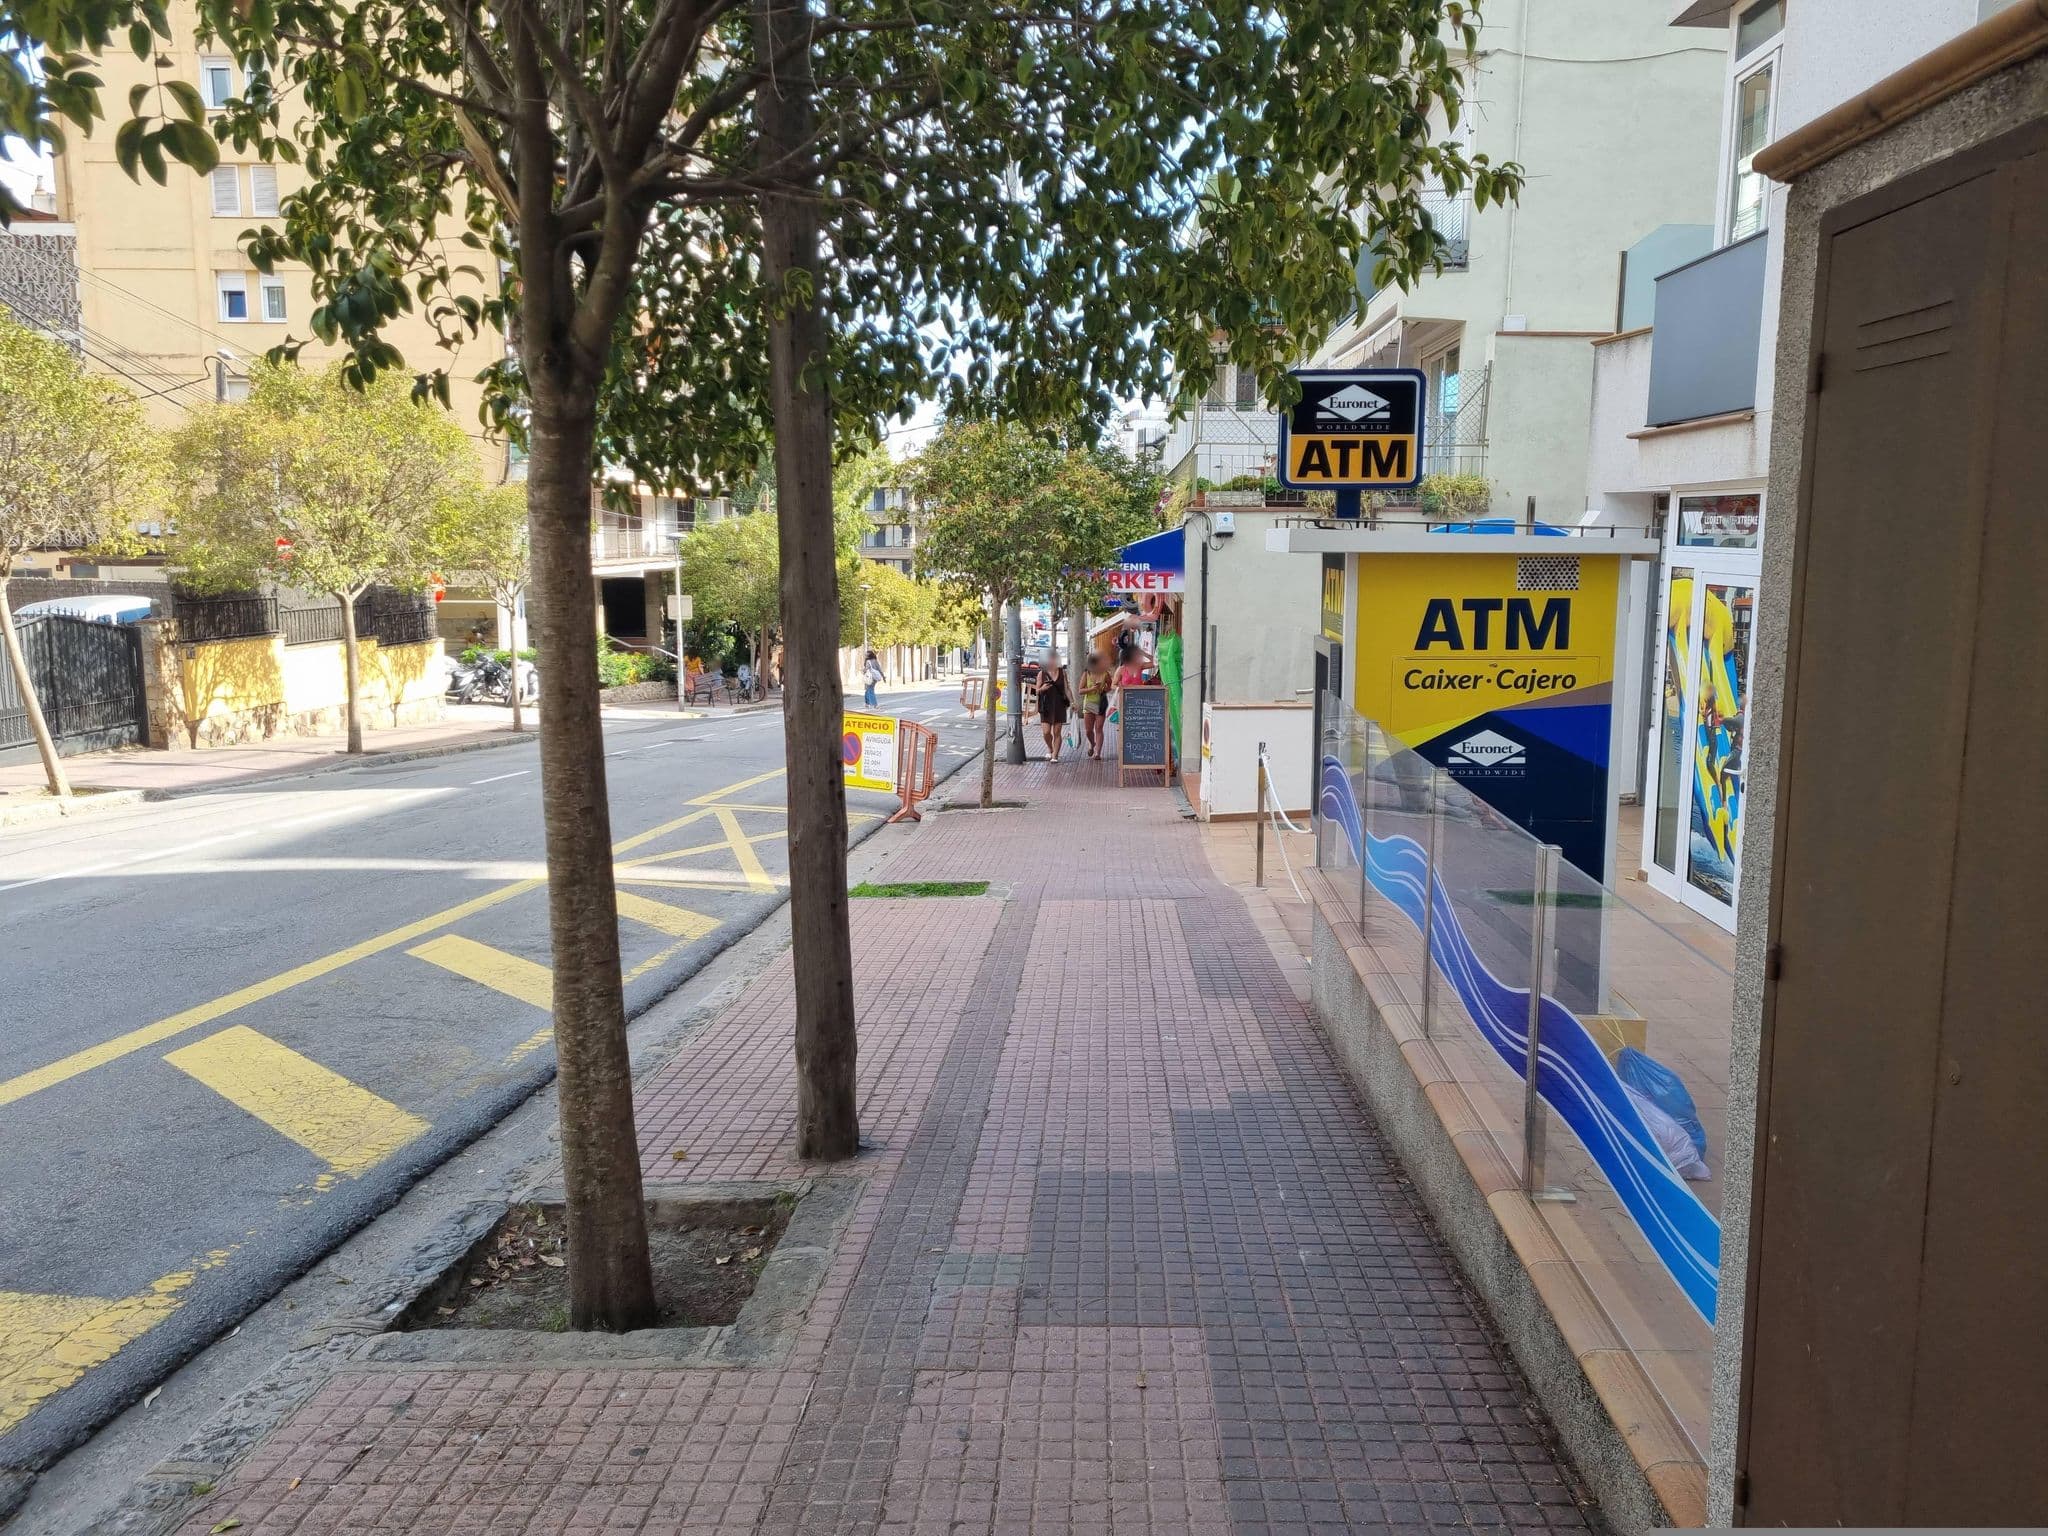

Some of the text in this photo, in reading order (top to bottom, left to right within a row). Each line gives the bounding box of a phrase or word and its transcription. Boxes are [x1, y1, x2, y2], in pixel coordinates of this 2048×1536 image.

[1329, 396, 1379, 409] Euronet
[1296, 439, 1408, 479] ATM
[1323, 567, 1344, 615] ATM
[1413, 597, 1571, 651] ATM
[1461, 742, 1513, 754] Euronet
[1448, 768, 1527, 776] WORLDWIDE
